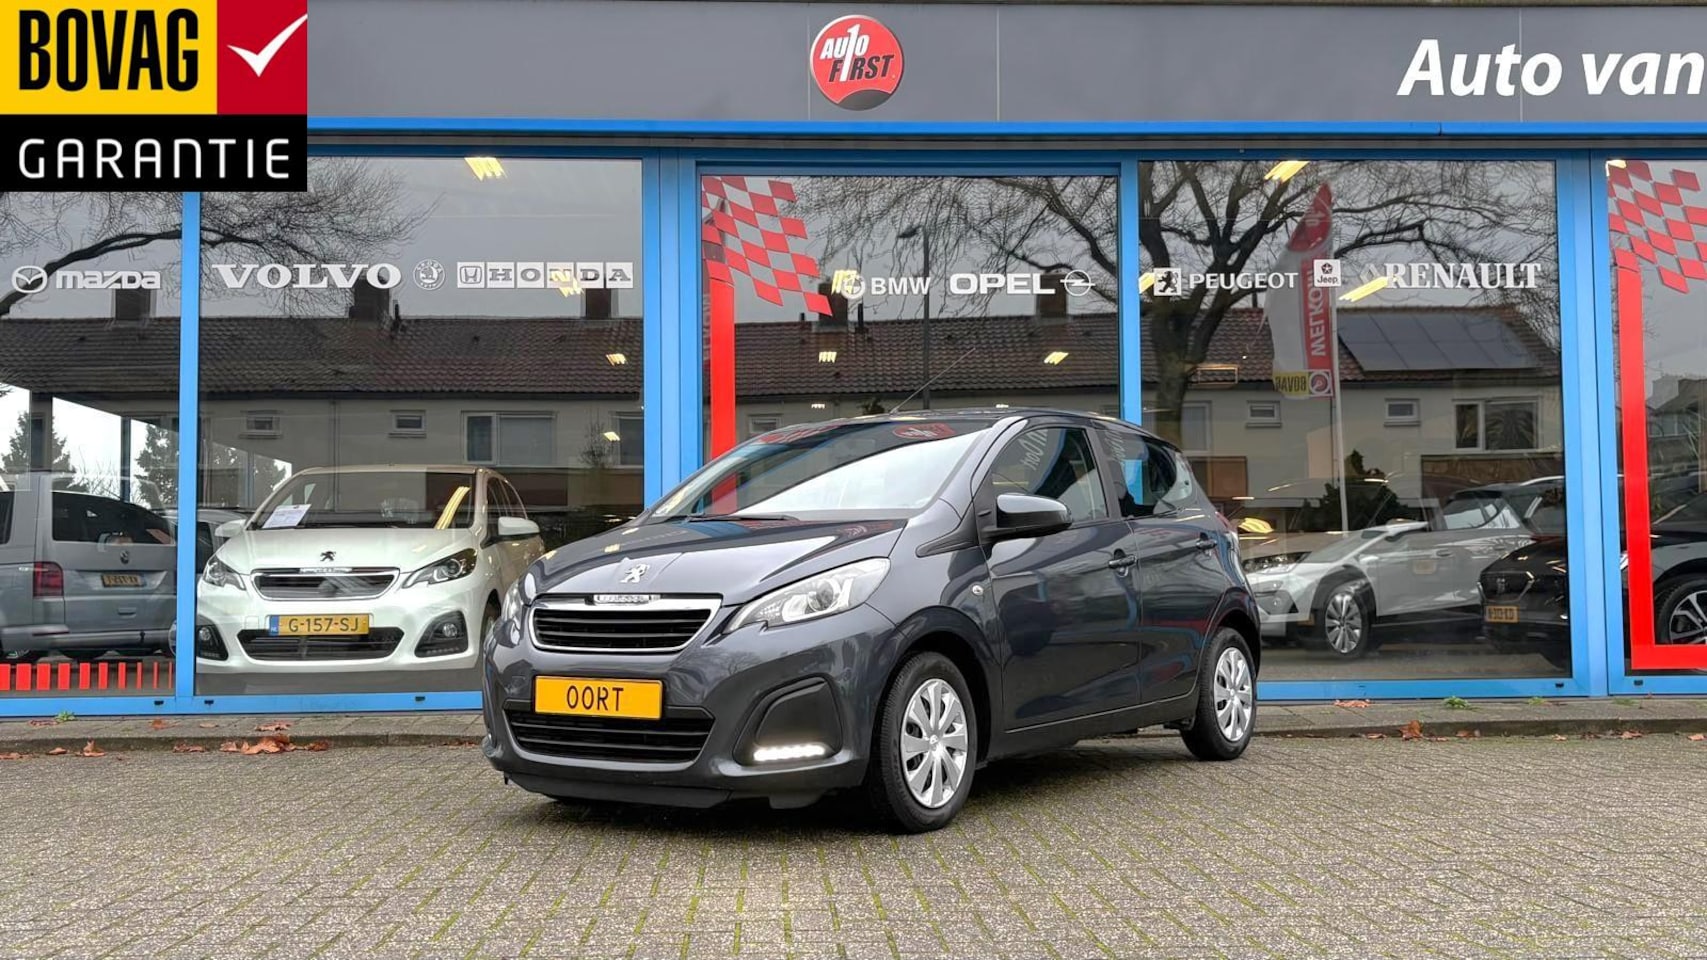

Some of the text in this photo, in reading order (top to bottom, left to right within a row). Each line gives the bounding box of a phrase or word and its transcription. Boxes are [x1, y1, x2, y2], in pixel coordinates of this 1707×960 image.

[1397, 39, 1705, 96] Auto van
[212, 262, 402, 289] VOLVO
[488, 266, 632, 283] HONDA
[949, 273, 1055, 295] OPEL
[1188, 272, 1298, 290] PEUGEOT
[1317, 275, 1338, 284] Jeep
[1384, 262, 1543, 289] RENAULT
[871, 277, 931, 295] BMW
[288, 618, 359, 633] G-157-SJ
[566, 685, 624, 711] OORT
